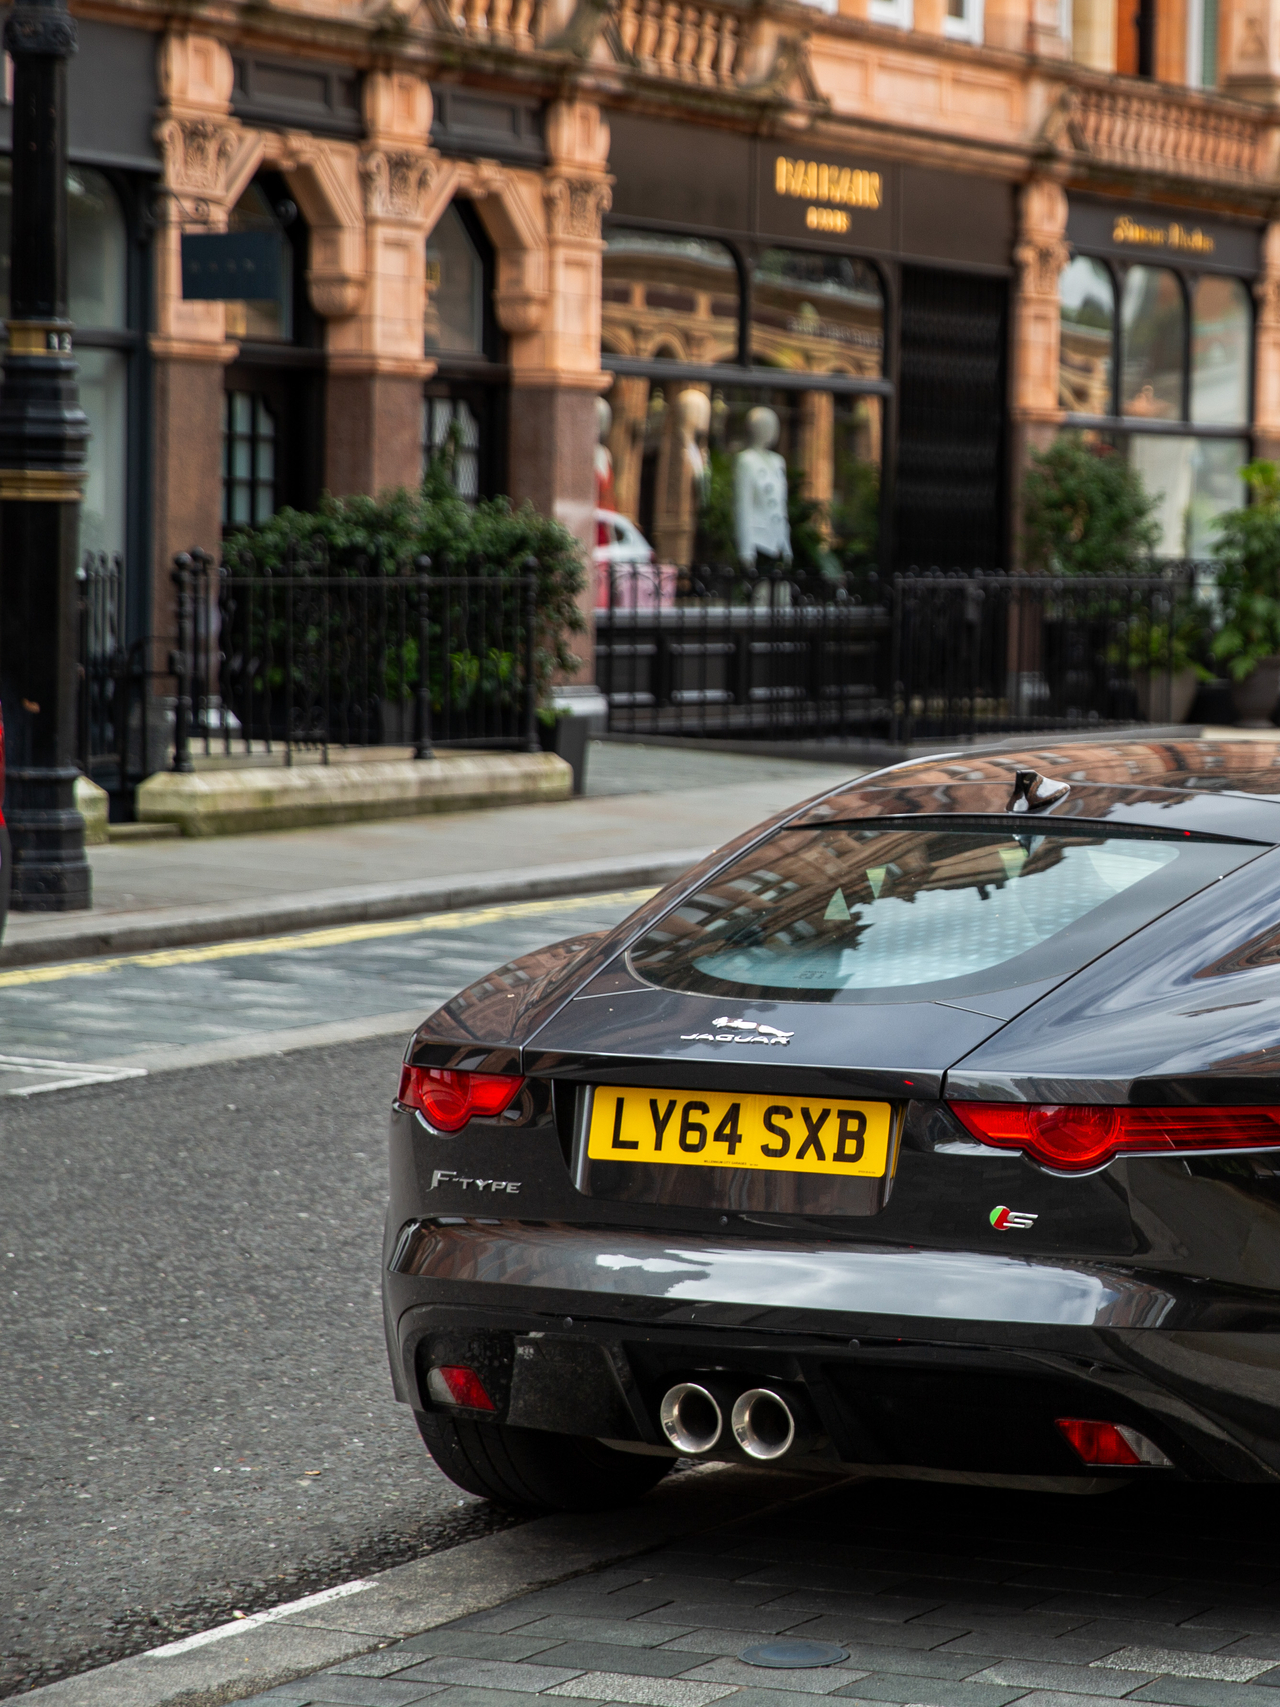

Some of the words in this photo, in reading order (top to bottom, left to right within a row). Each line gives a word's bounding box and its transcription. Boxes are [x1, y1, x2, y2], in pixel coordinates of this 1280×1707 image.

[680, 1032, 790, 1046] JAGUAR
[611, 1096, 743, 1156] LY64
[760, 1104, 867, 1163] SXB
[426, 1169, 523, 1194] F-TYPE
